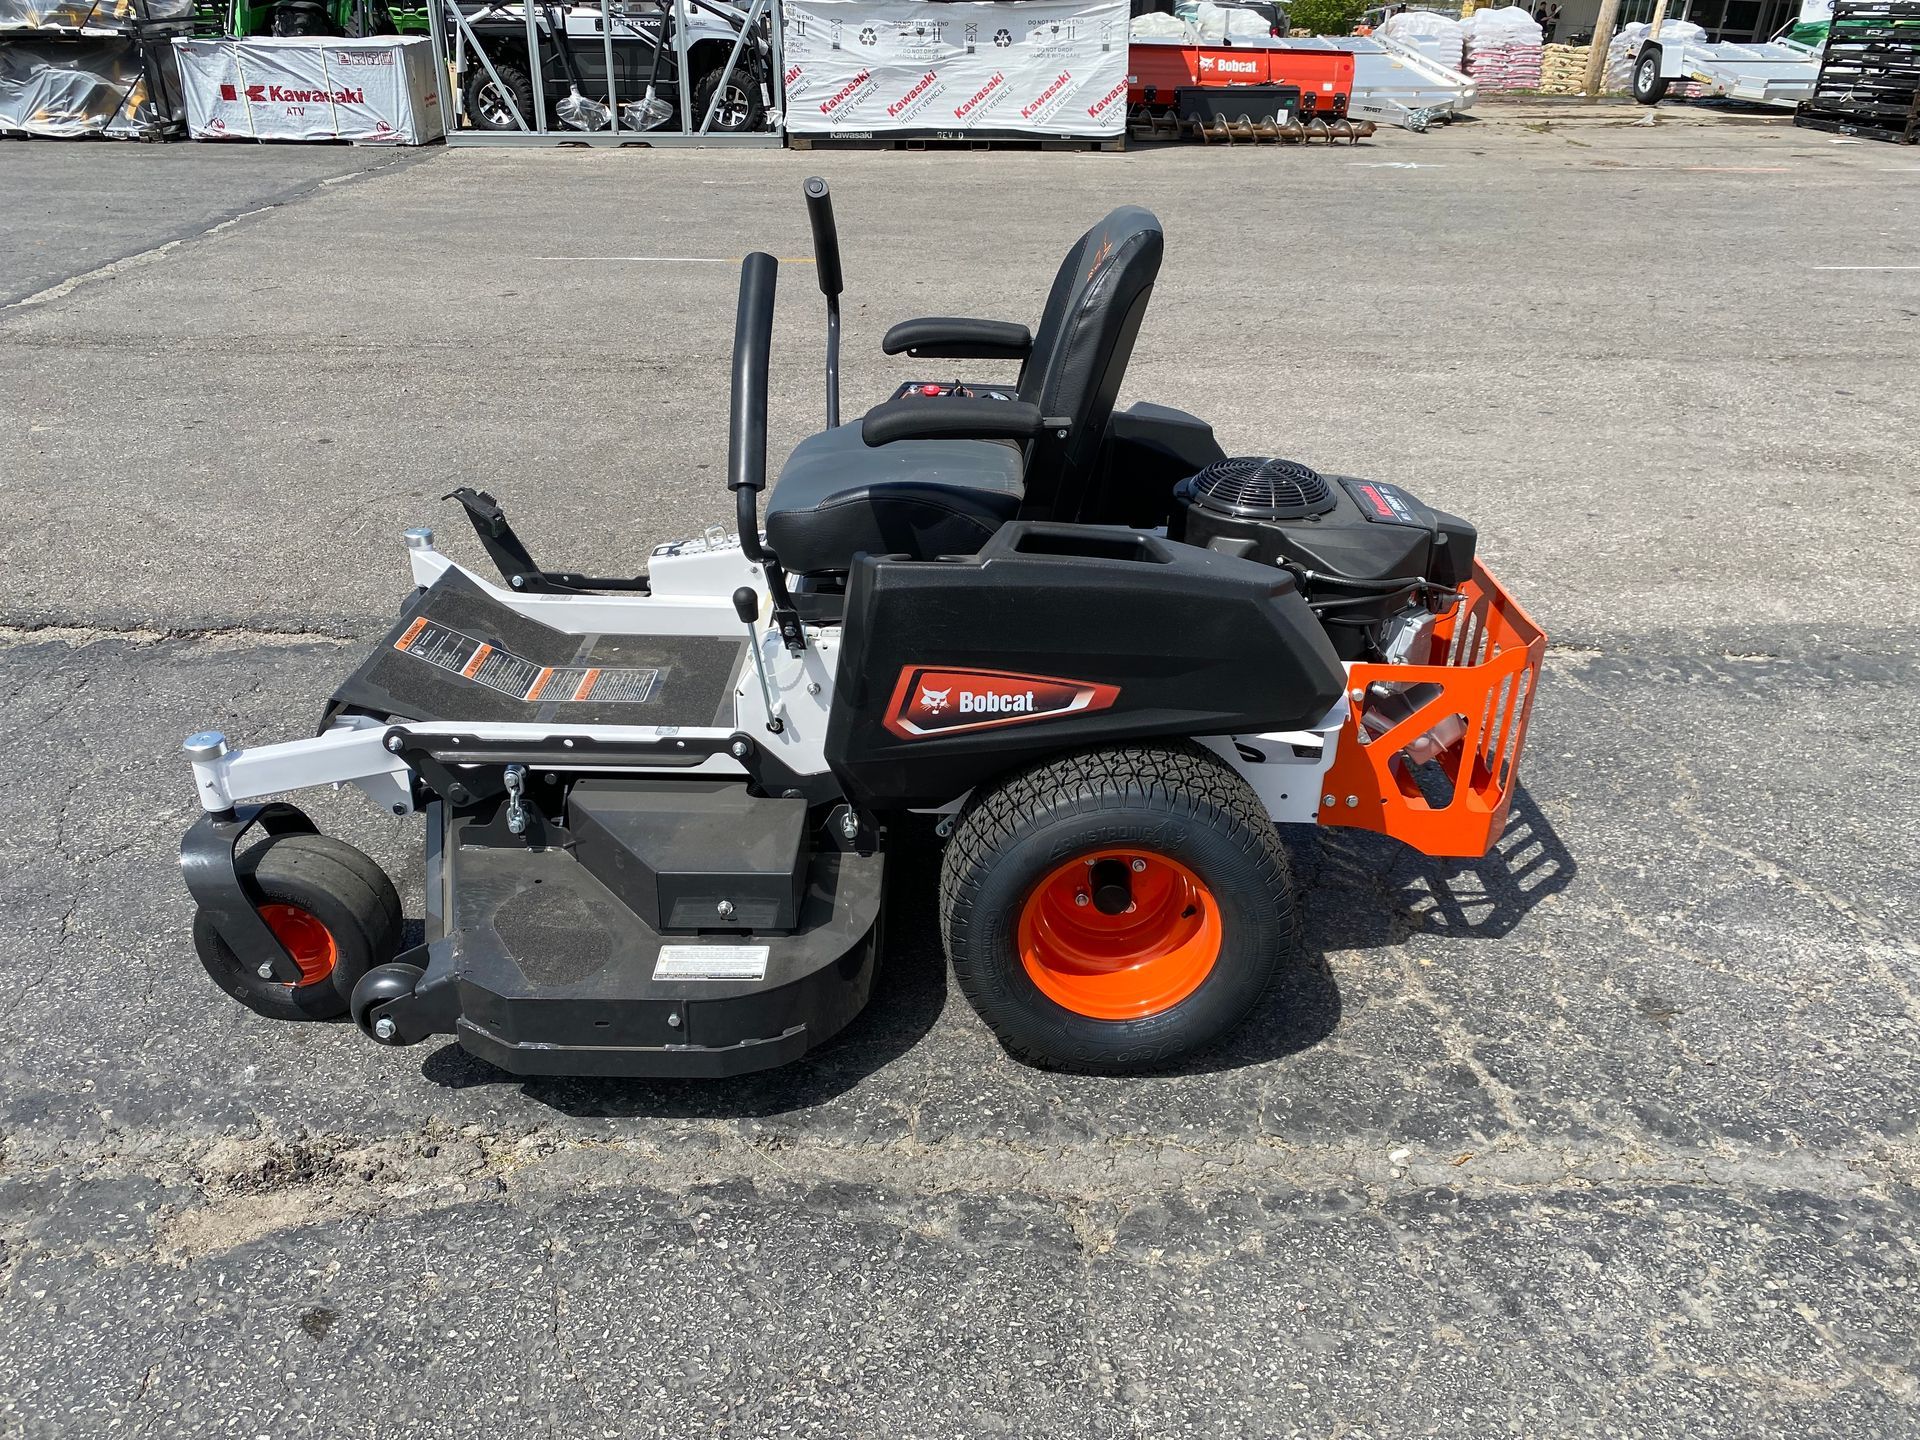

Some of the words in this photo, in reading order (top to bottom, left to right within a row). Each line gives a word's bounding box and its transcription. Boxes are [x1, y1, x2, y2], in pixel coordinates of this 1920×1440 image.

[1218, 58, 1257, 73] Bobcat
[269, 86, 364, 104] Kawasaki
[786, 80, 812, 102] VEHICLE
[819, 68, 871, 114] Kawasaki
[832, 103, 855, 125] UTILITY
[854, 82, 880, 106] VEHICLE
[886, 69, 938, 117] Kawasaki
[954, 70, 1004, 119] Kawasaki
[988, 85, 1014, 110] VEHICLE
[1020, 70, 1072, 119] Kawasaki
[1055, 83, 1081, 108] VEHICLE
[1087, 74, 1128, 118] Kawasa
[286, 106, 305, 116] ATV
[900, 106, 922, 126] TILITY
[922, 84, 947, 108] VEHICLE
[1100, 106, 1123, 128] UTILITY
[830, 131, 873, 139] Kawasaki
[960, 691, 1034, 713] Bobcat
